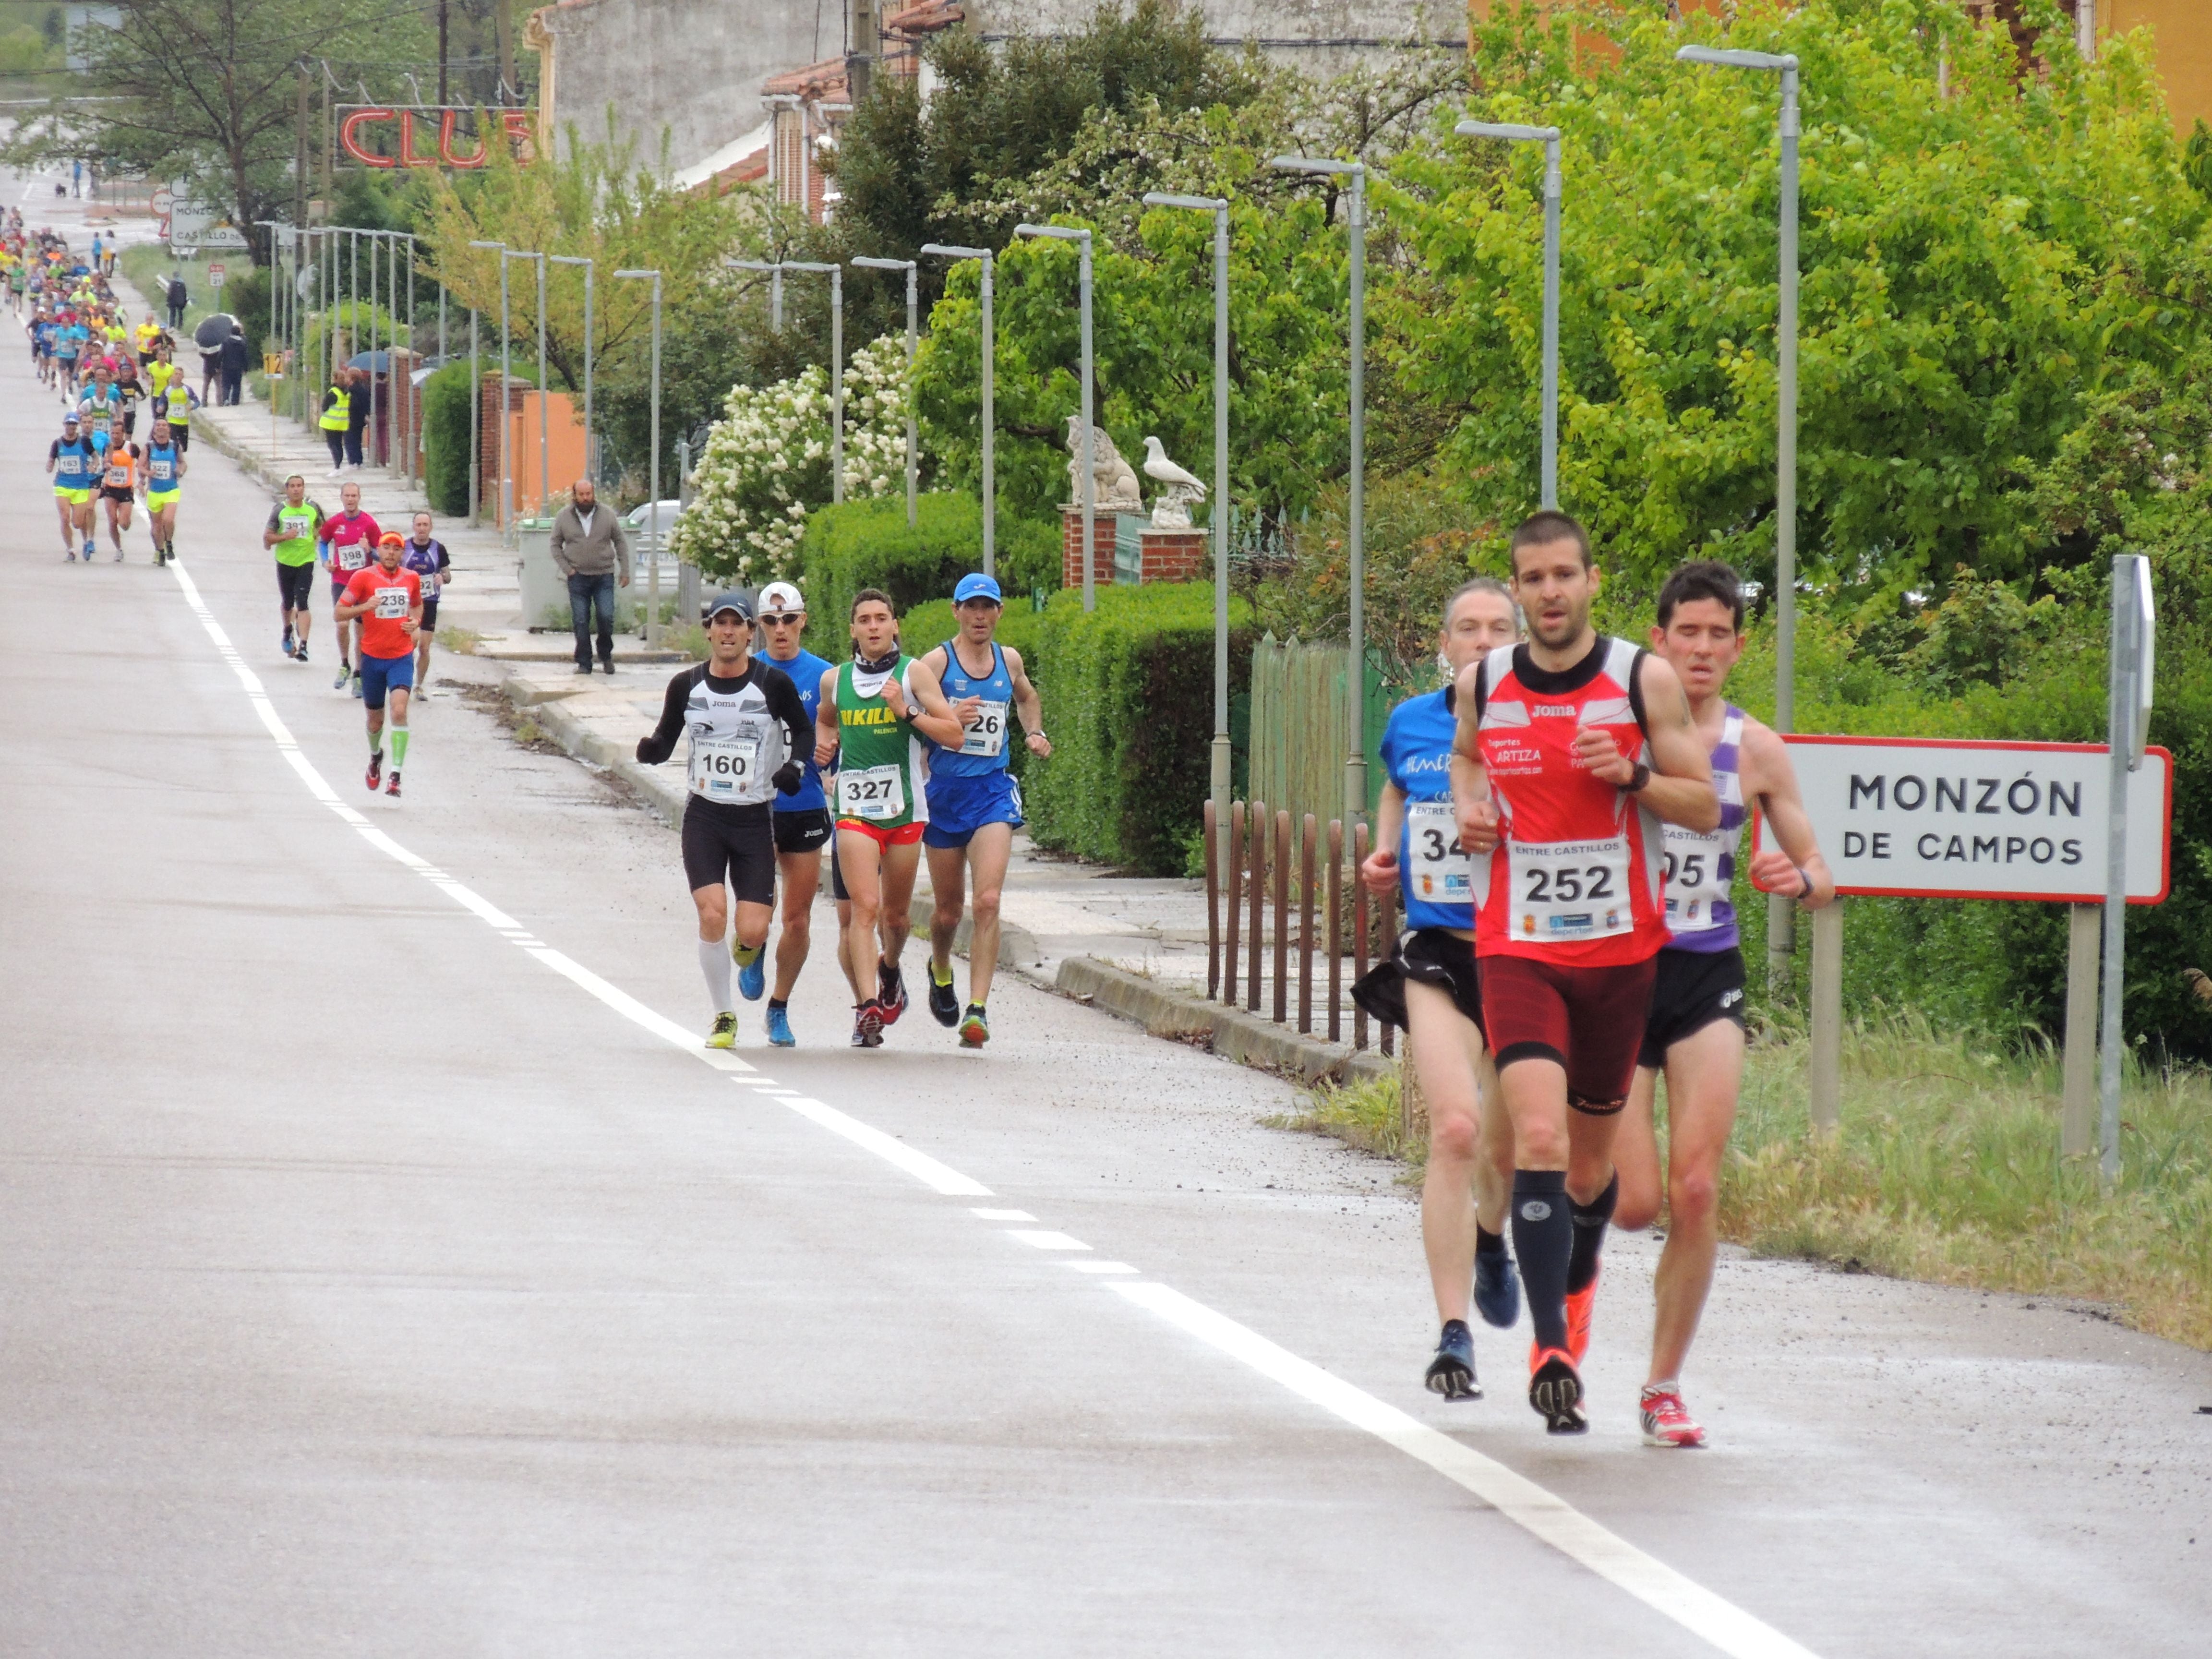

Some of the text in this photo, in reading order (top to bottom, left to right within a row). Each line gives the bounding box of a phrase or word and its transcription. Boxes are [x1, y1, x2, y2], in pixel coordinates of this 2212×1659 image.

[177, 230, 227, 239] CASTLLO
[342, 551, 362, 561] 398
[381, 595, 405, 606] 238
[1497, 749, 1541, 763] ARTIZA
[702, 754, 746, 776] 160
[862, 767, 896, 775] CASTILLOS
[847, 779, 893, 801] 327
[1850, 771, 2082, 817] MONZÓN
[1416, 806, 1446, 815] ENTRE
[1515, 842, 1620, 856] ENTRE CASTILLOS
[1844, 831, 2083, 866] DE CAMPOS
[1526, 866, 1614, 902] 252
